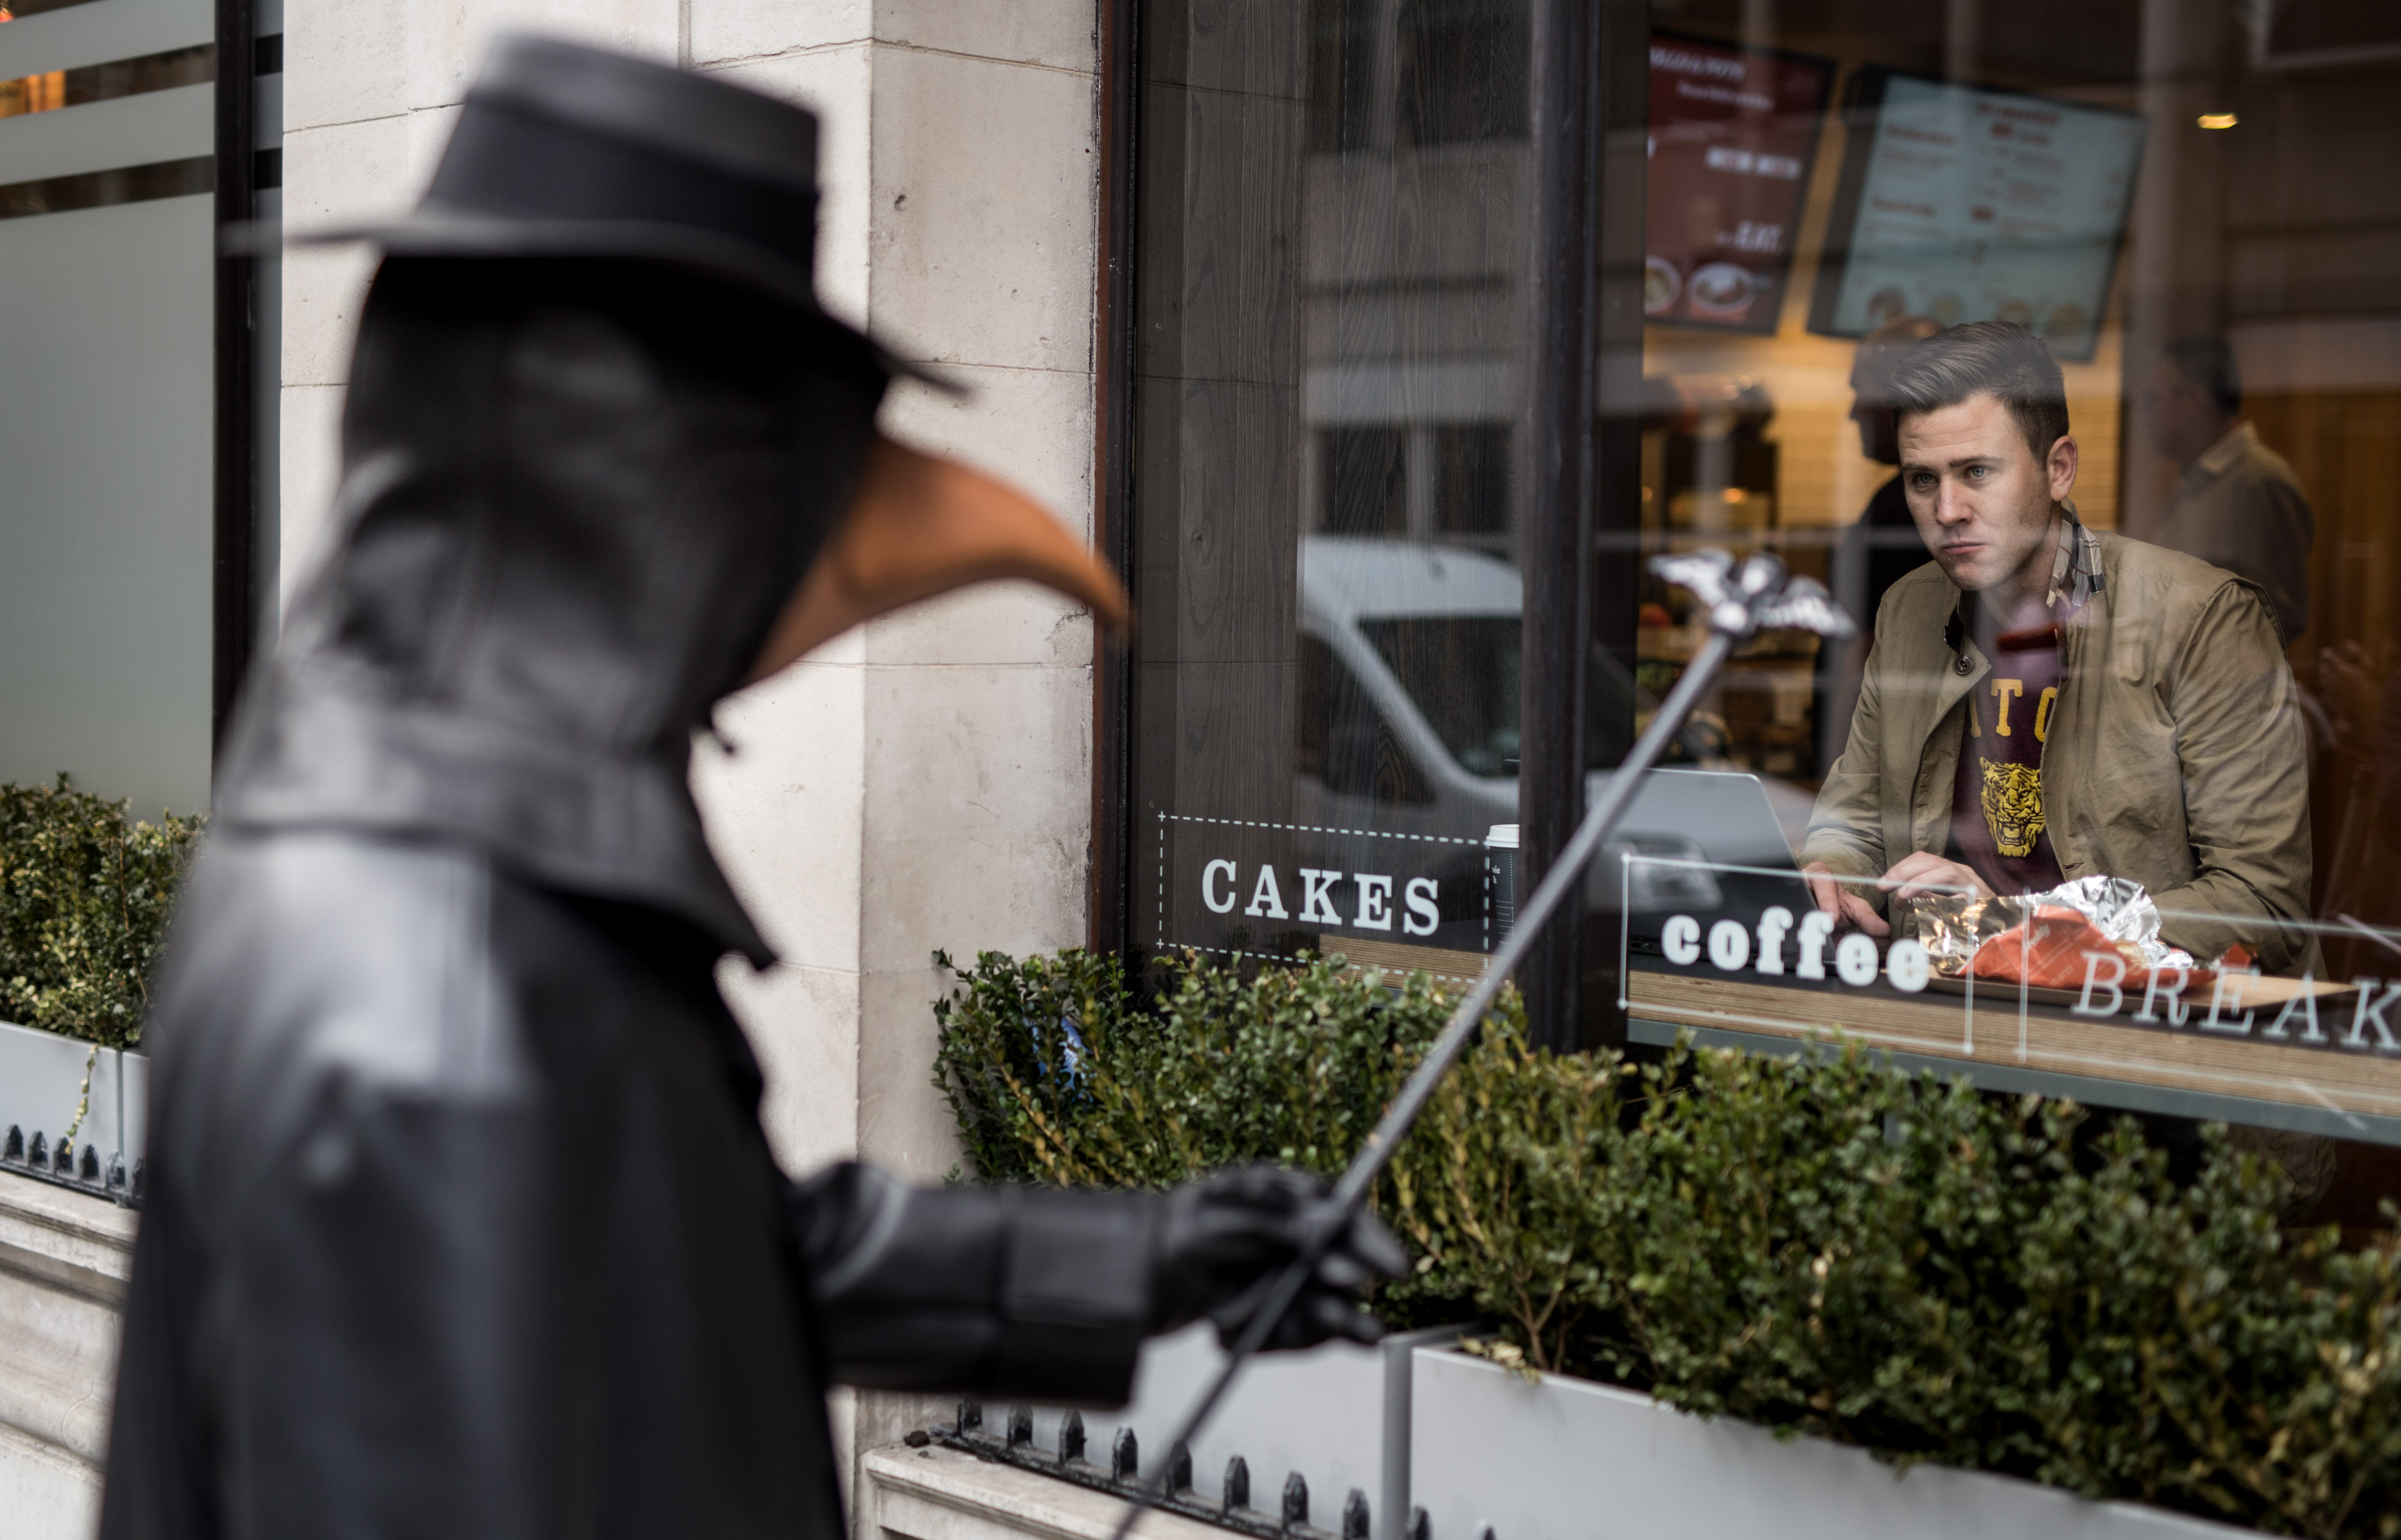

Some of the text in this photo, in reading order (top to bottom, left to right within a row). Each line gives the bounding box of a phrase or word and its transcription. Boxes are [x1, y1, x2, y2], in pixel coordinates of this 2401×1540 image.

[1202, 859, 1440, 936] CAKES
[1661, 906, 1930, 993] coffee
[2069, 950, 2401, 1051] BREAK
